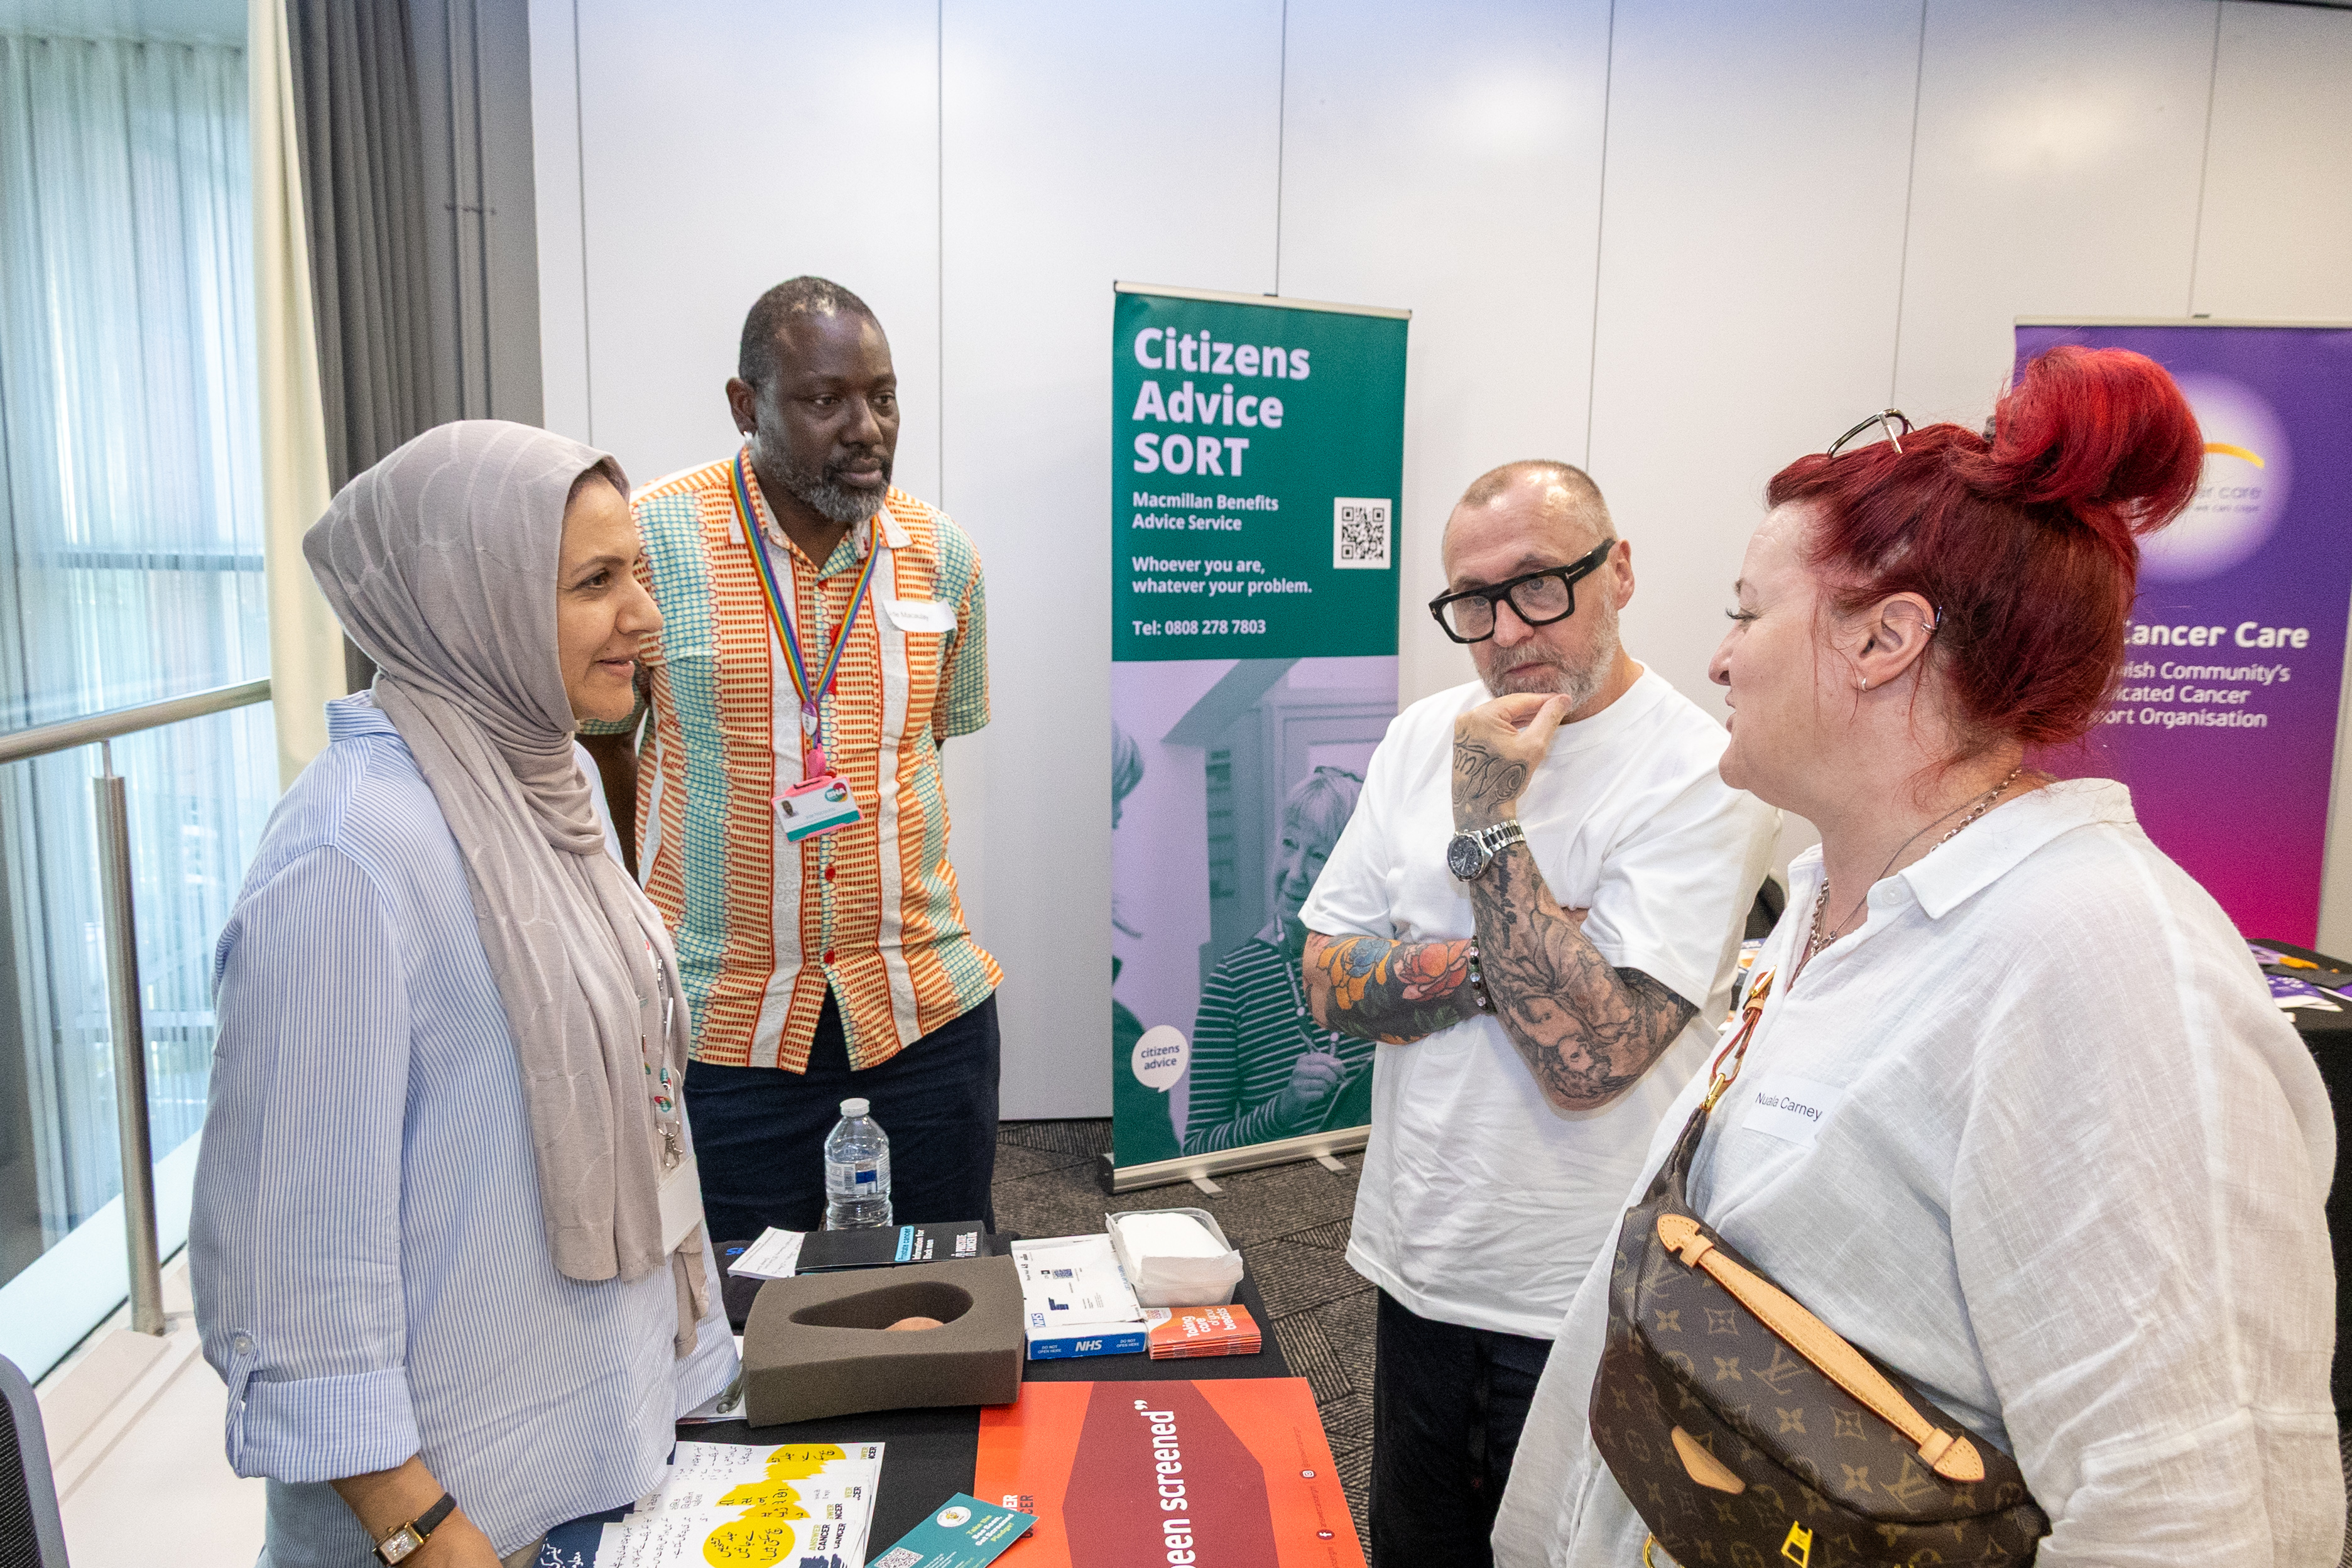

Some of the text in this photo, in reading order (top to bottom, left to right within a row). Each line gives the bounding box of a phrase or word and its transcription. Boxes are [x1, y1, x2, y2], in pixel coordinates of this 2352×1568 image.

[1134, 326, 1311, 380] Citizens
[1132, 381, 1284, 429] Advice
[1133, 432, 1250, 477] SORT
[1133, 492, 1279, 511] Macmillan Benefits
[1132, 513, 1243, 531] Advice Service
[1132, 557, 1266, 576] Whoever you are,
[1133, 579, 1312, 597] whatever your problem.
[1133, 619, 1266, 636] Tel: 0808 278 7803
[2235, 621, 2310, 648] Care
[2160, 662, 2292, 686] Community's
[2179, 685, 2252, 705] Cancer
[2104, 707, 2268, 729] ort Organisation
[1141, 1045, 1180, 1058] citizens
[1144, 1057, 1177, 1070] advice
[1755, 1092, 1822, 1122] Nuala Carney
[902, 1228, 911, 1244] cancer
[915, 1229, 924, 1237] for
[1032, 1313, 1045, 1327] NHS
[1204, 1309, 1220, 1320] your
[1216, 1307, 1237, 1331] breasts
[1182, 1315, 1200, 1338] Taking
[1196, 1317, 1211, 1332] care
[1075, 1340, 1102, 1352] NHS
[808, 1524, 821, 1551] ANSWER
[817, 1524, 830, 1551] CANCER
